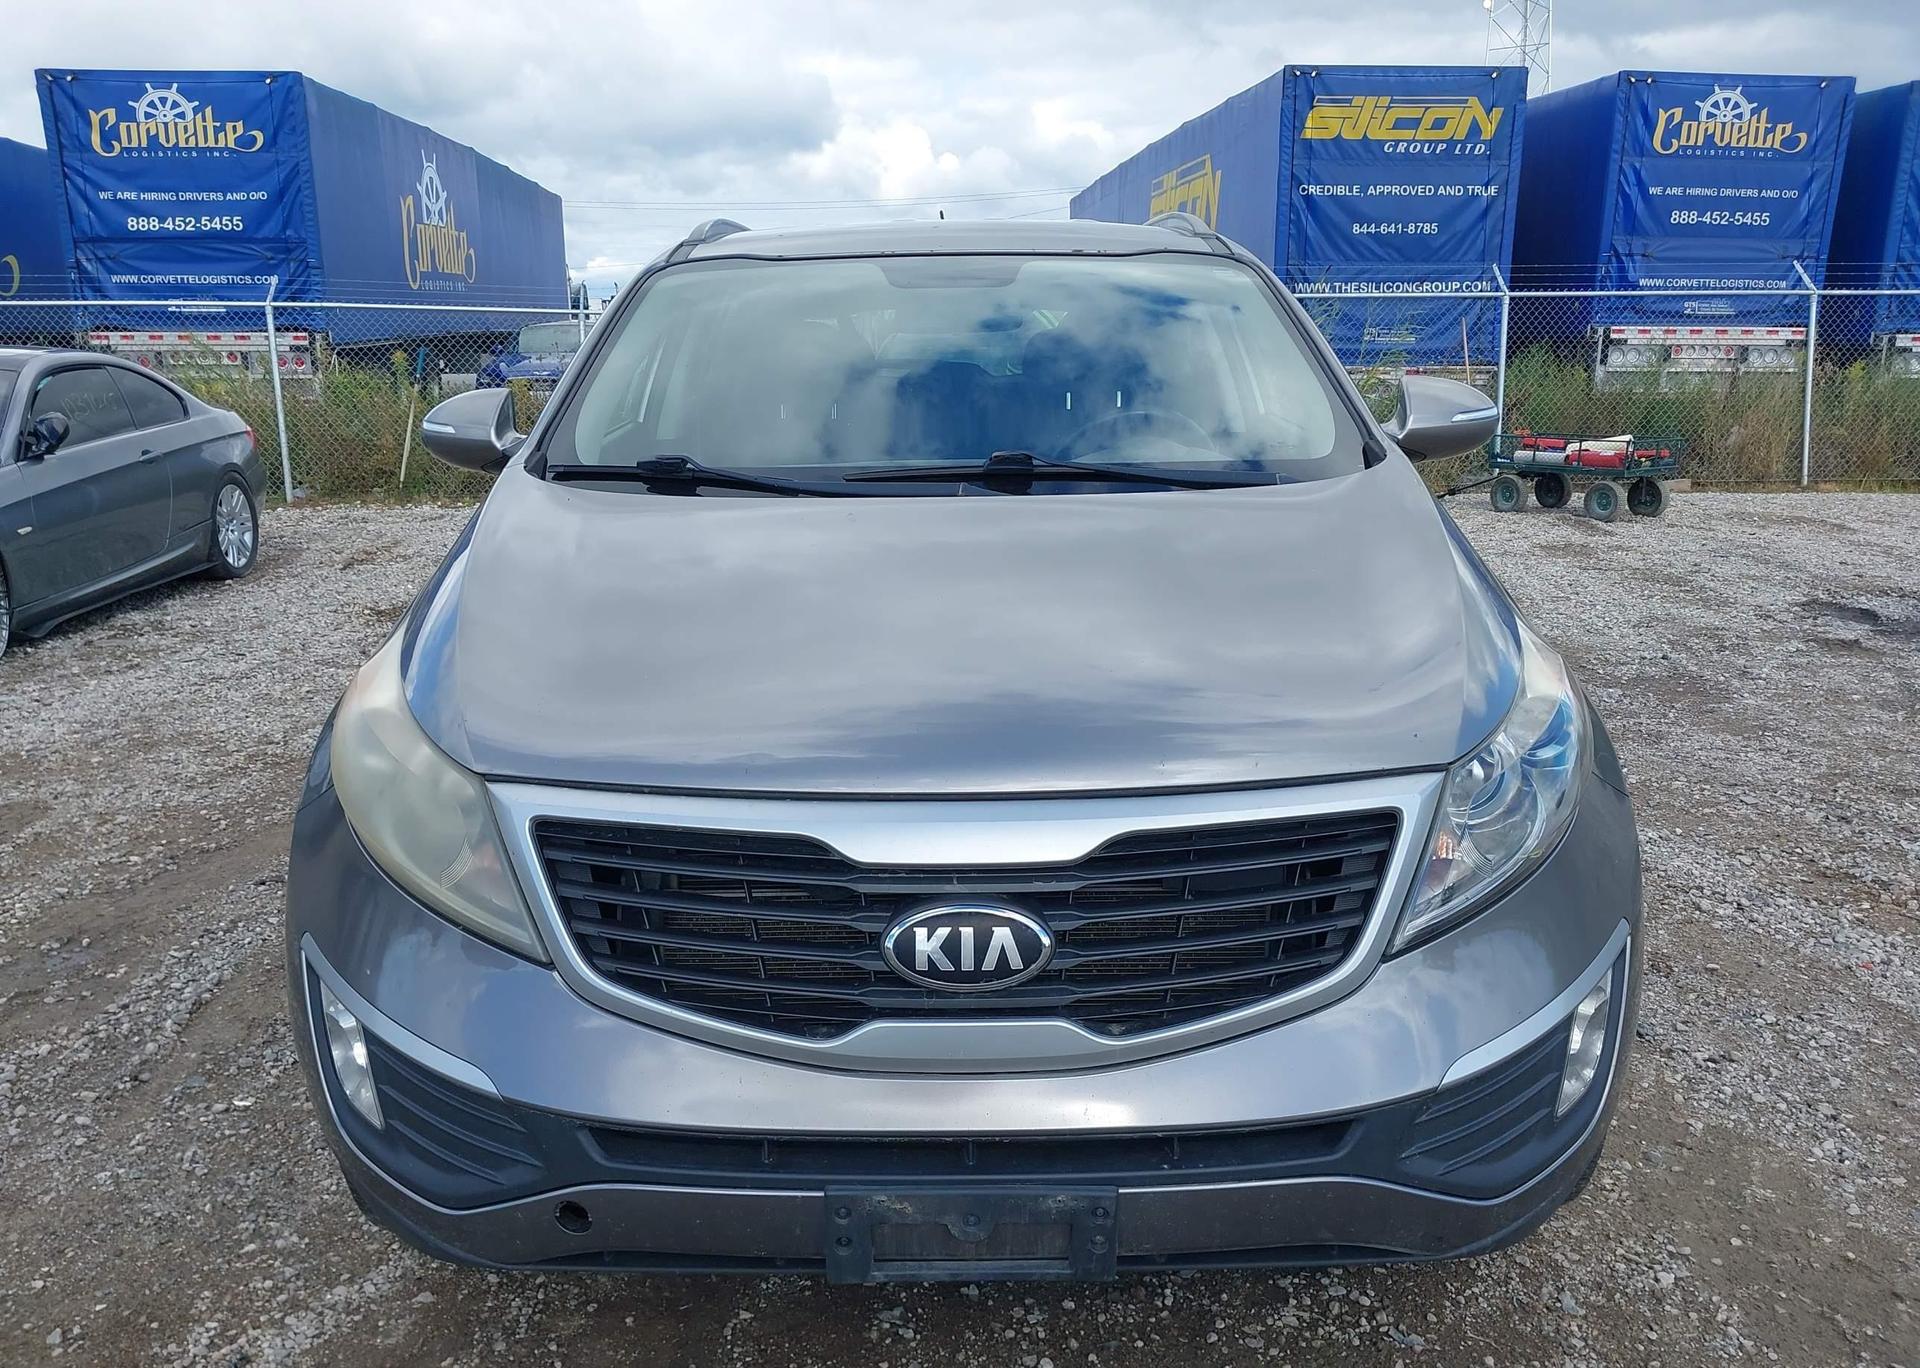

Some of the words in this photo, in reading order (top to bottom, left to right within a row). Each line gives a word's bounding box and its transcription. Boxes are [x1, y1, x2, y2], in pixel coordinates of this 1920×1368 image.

[88, 105, 264, 157] Corvette
[1653, 107, 1808, 155] Corvette
[1384, 141, 1447, 154] GROUP
[1454, 143, 1491, 155] LTD.
[1679, 149, 1745, 157] LOGISTICS
[99, 191, 115, 200] WE
[116, 191, 138, 200] ARE
[140, 192, 177, 201] HIRING
[178, 192, 224, 201] DRIVERS
[226, 192, 247, 201] AND
[249, 191, 268, 200] O/O
[1299, 184, 1364, 197] CREDIBLE,
[1367, 185, 1435, 196] APPROVED
[1437, 185, 1464, 196] AND
[1467, 185, 1499, 196] TRUE
[1649, 186, 1664, 195] WE
[1665, 187, 1684, 196] ARE
[1686, 187, 1718, 197] HIRING
[1720, 188, 1759, 198] DRIVERS
[1760, 188, 1780, 199] AND
[1781, 190, 1799, 199] O/O
[127, 216, 243, 231] 888-452-5455
[1670, 210, 1770, 226] 888-452-5455
[1352, 222, 1439, 235] 844-641-8785
[400, 195, 476, 289] Corvette
[111, 274, 279, 285] WWW.CORVETTELOGISTICS.COM
[1638, 278, 1787, 289] WWW.CORVETTELOGISTICS.COM
[1294, 281, 1491, 294] WWW.THESILICONGROUP.COM
[913, 926, 1024, 971] KIA
